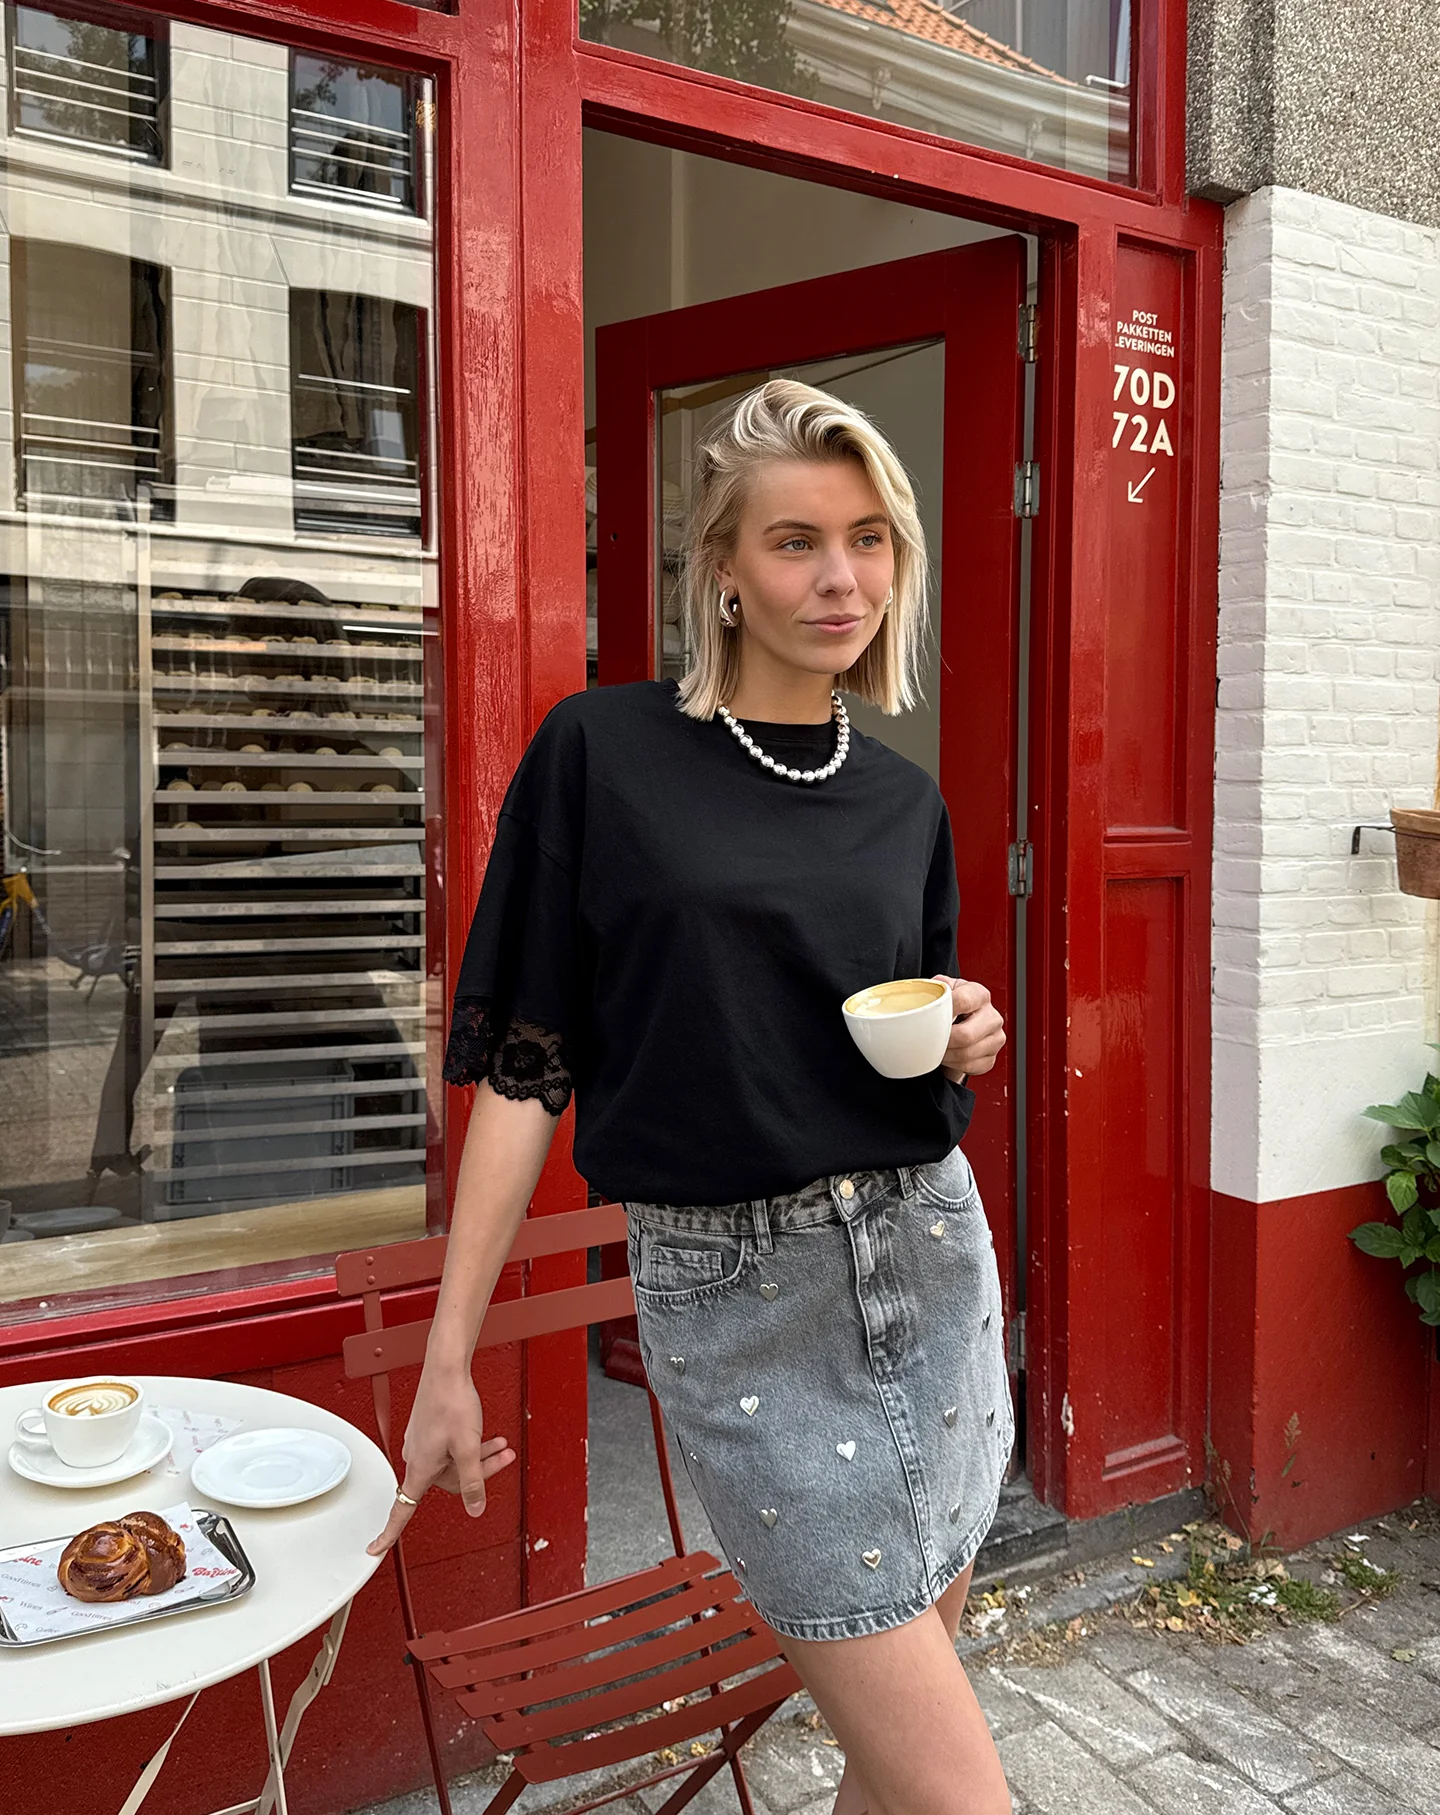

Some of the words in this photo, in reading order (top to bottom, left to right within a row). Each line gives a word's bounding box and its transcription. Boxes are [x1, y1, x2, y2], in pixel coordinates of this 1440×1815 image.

[1116, 321, 1172, 343] PAKKETTEN
[1132, 310, 1158, 326] POST
[1113, 364, 1176, 410] 70D
[1112, 411, 1174, 457] 72A
